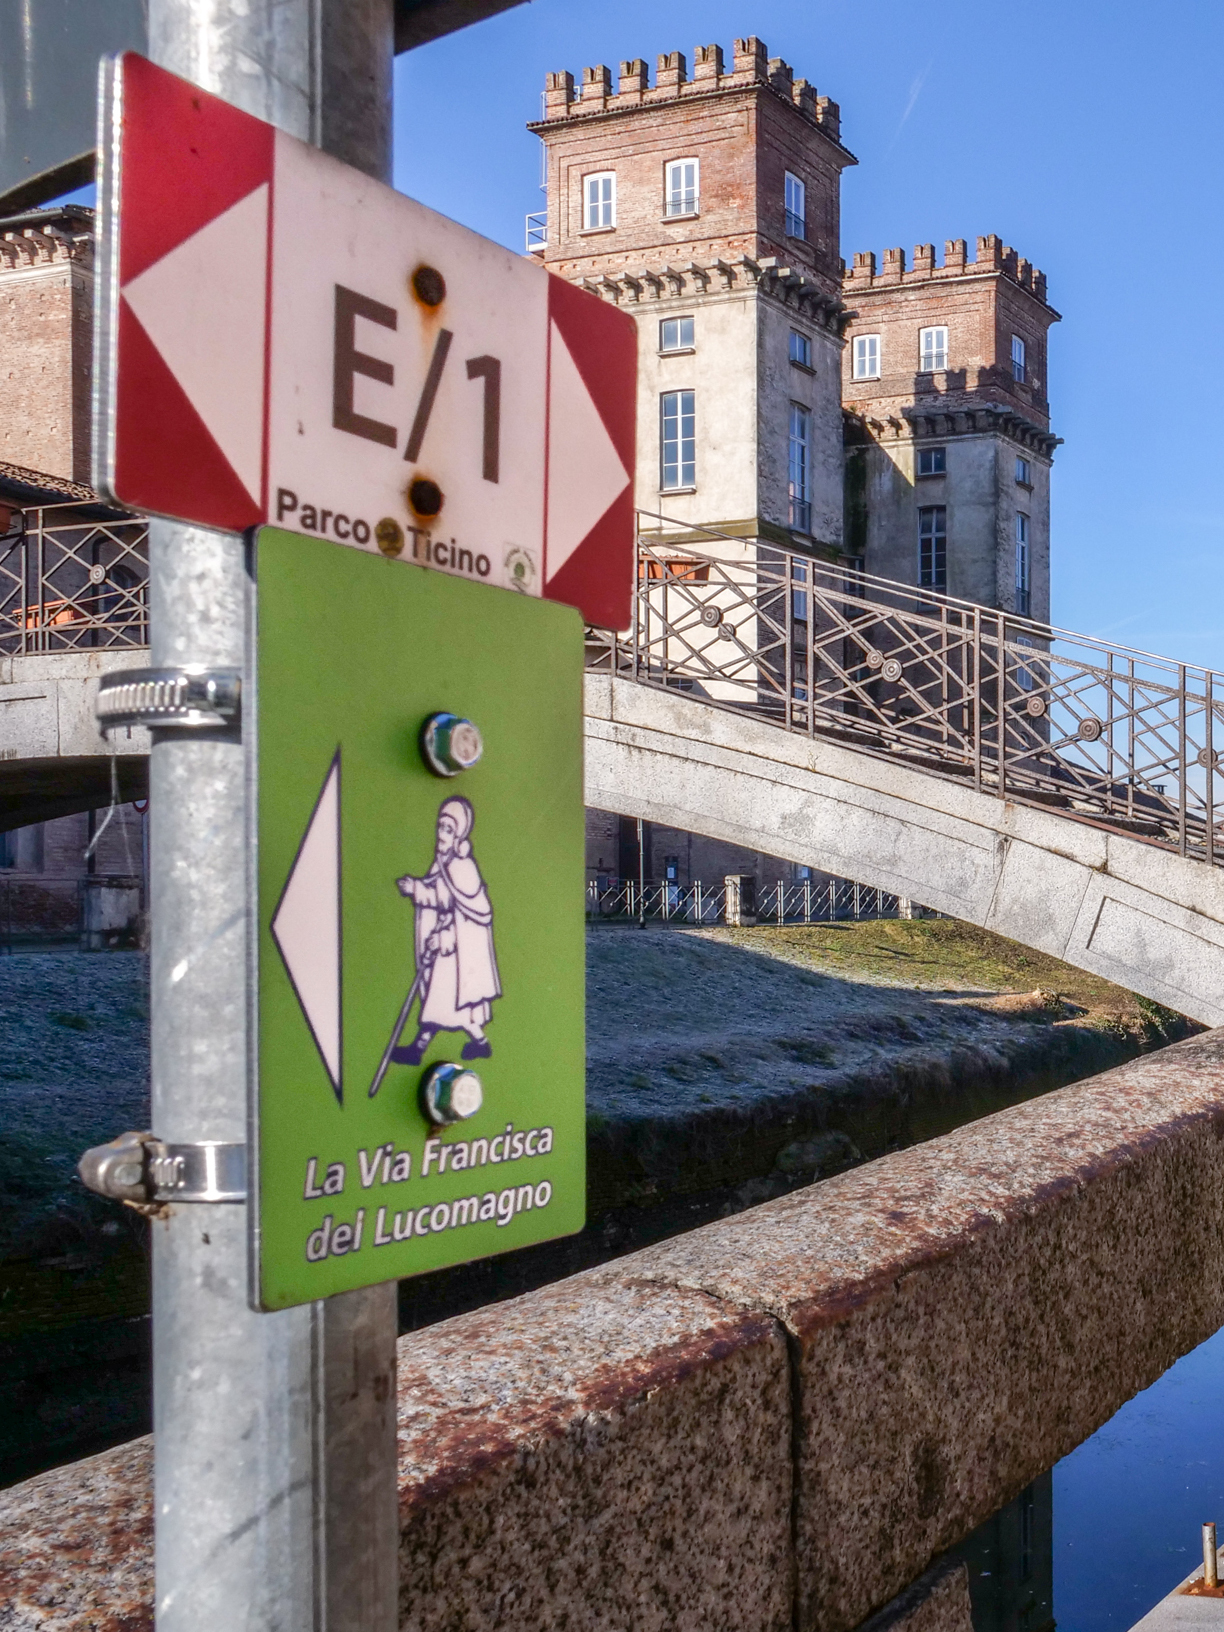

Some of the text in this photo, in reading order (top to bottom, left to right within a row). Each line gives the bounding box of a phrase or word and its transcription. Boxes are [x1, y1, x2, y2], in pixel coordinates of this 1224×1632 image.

[333, 283, 501, 484] E/1
[276, 488, 371, 544] Parco
[407, 525, 491, 577] Ticino
[304, 1123, 554, 1200] La Via Francisca
[306, 1180, 553, 1262] del Lucomagno
